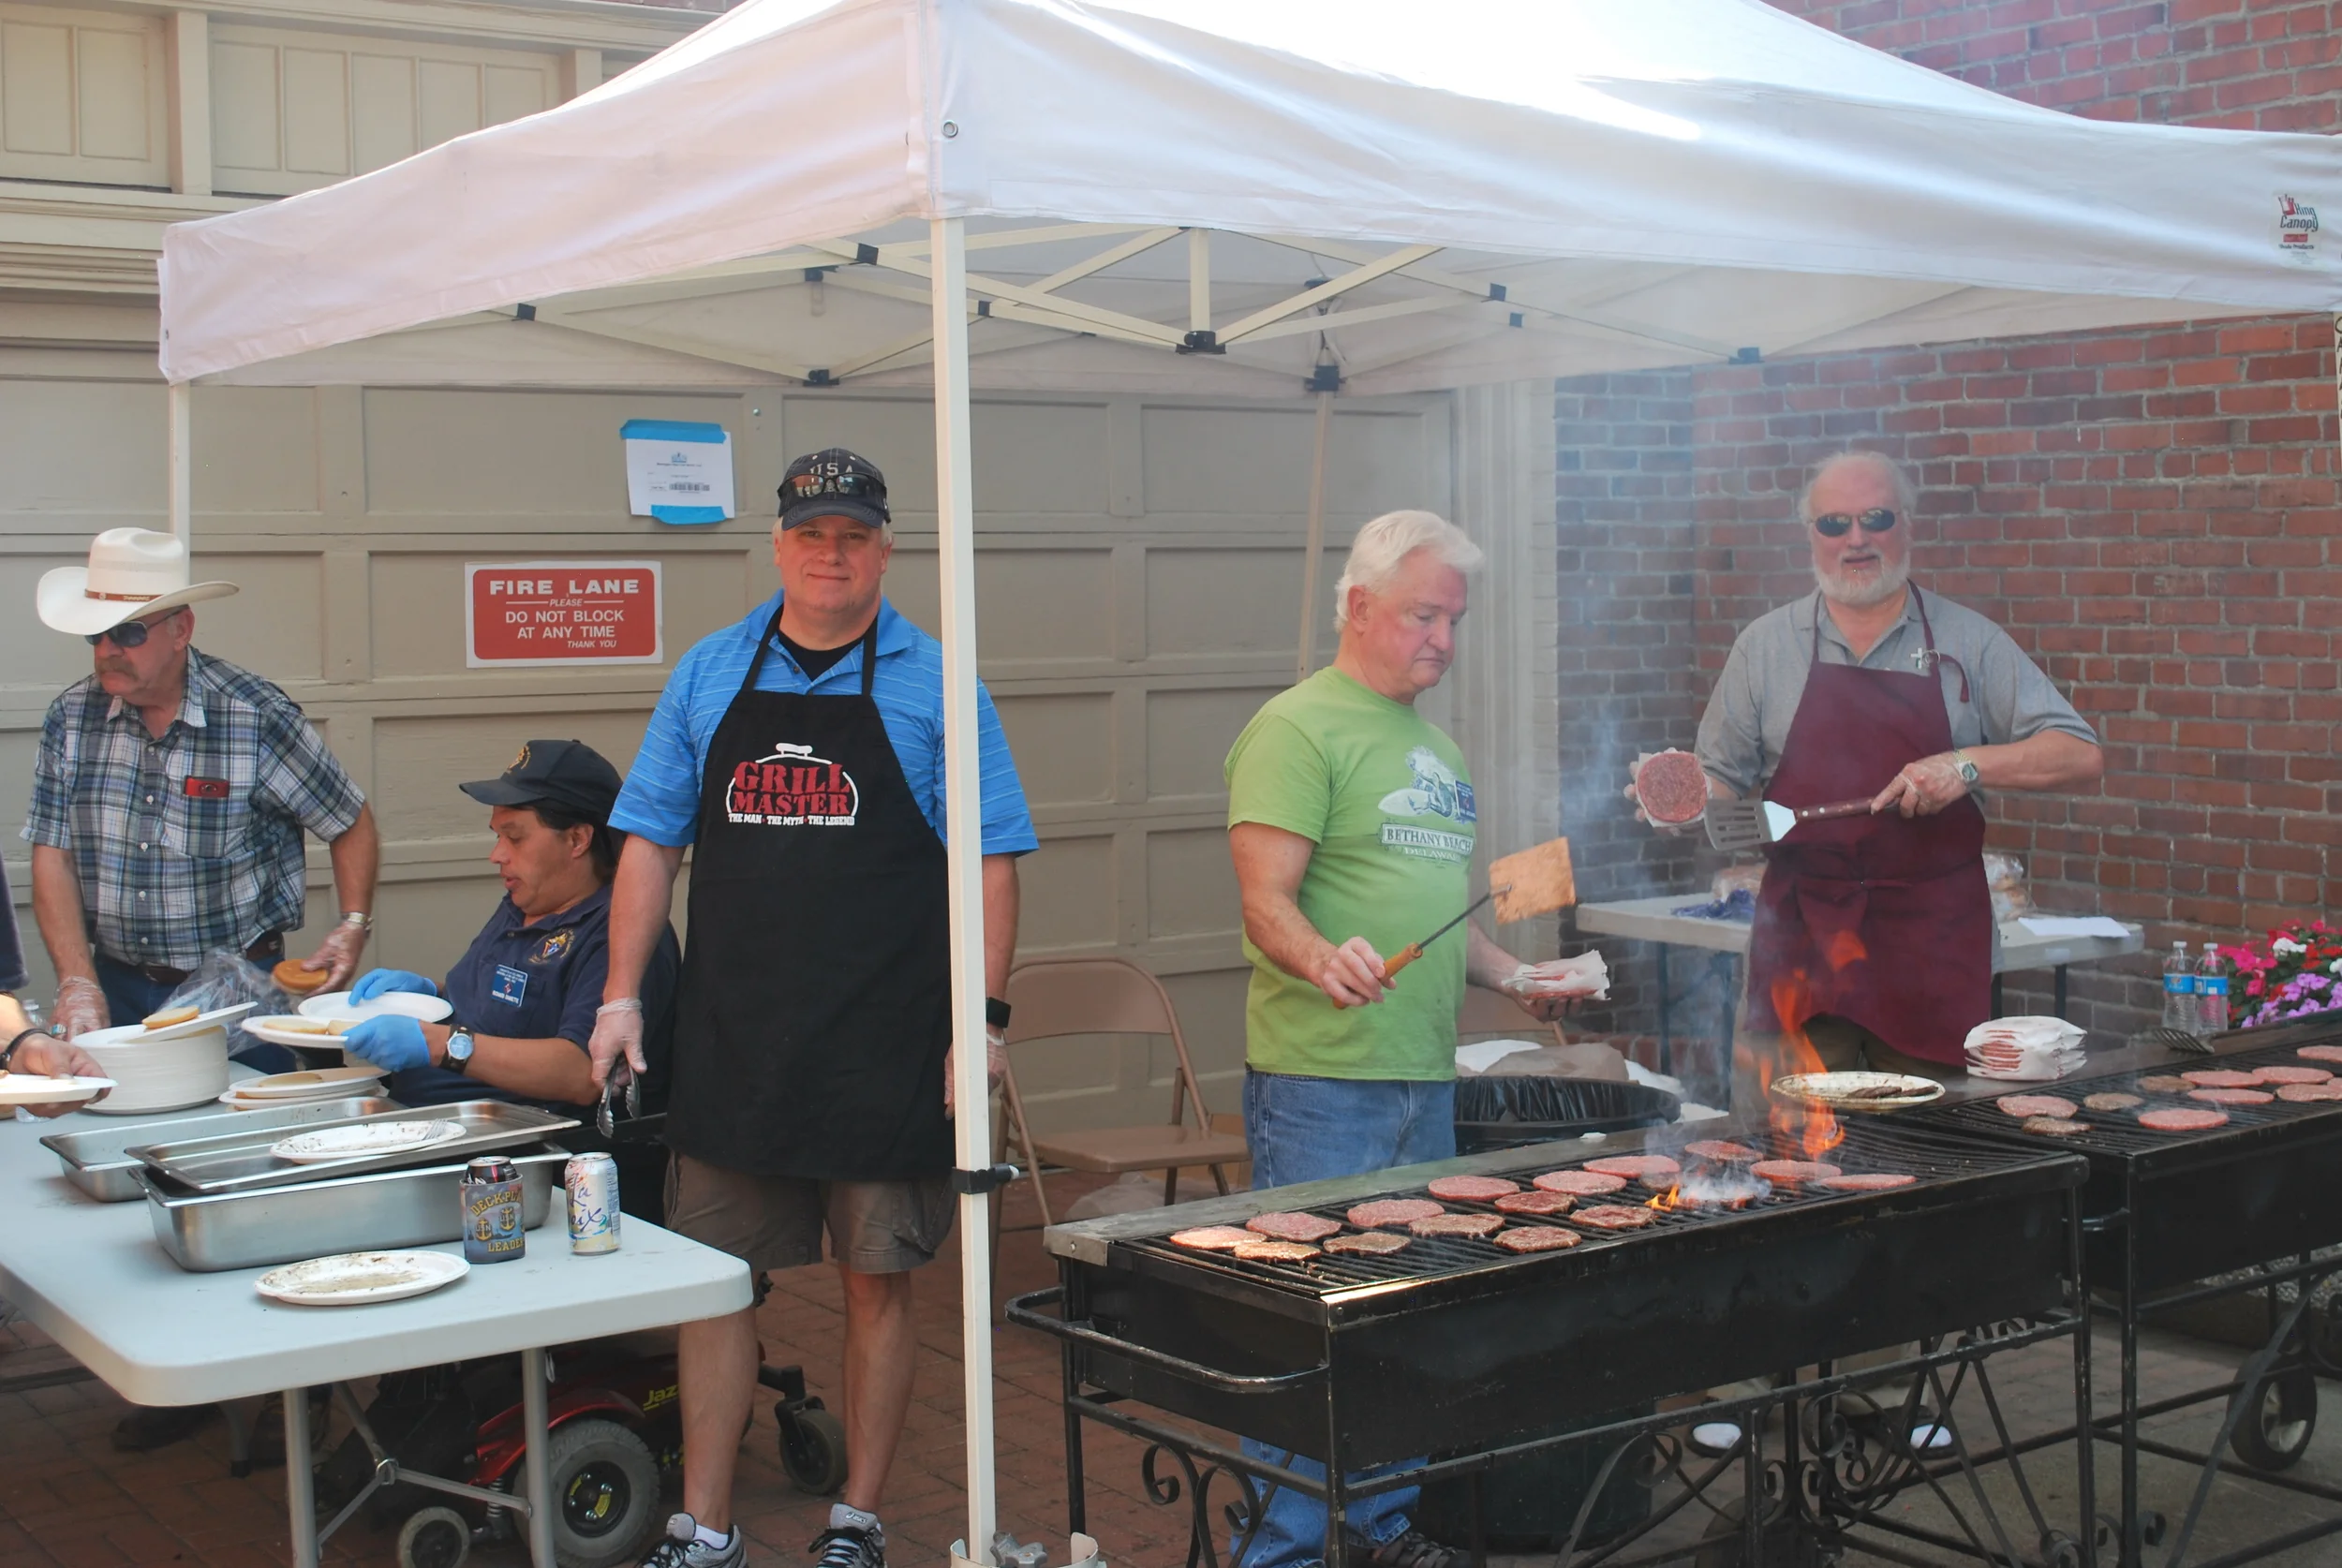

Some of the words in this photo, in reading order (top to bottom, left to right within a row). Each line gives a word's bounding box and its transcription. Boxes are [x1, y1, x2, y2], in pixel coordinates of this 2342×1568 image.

[2294, 203, 2317, 216] King
[2280, 214, 2319, 232] Canopy
[489, 579, 554, 596] FIRE
[569, 579, 640, 595] LANE
[549, 598, 583, 607] PLEASE
[505, 611, 528, 624] DO
[535, 610, 567, 623] NOT
[573, 610, 625, 622] BLOCK
[517, 627, 536, 639] AT
[542, 626, 572, 639] ANY
[580, 626, 615, 638] TIME
[567, 640, 596, 648] THANK
[600, 640, 617, 648] YOU
[734, 761, 851, 795] GRILL
[732, 791, 851, 816] MASTER
[728, 813, 743, 822] THE
[744, 814, 763, 823] MAN
[767, 815, 782, 825] THE
[782, 816, 804, 825] MYTH
[808, 815, 824, 825] THE
[825, 816, 855, 826] LEGEND
[1386, 828, 1441, 847] BETHANY
[643, 1384, 679, 1407] Jaz
